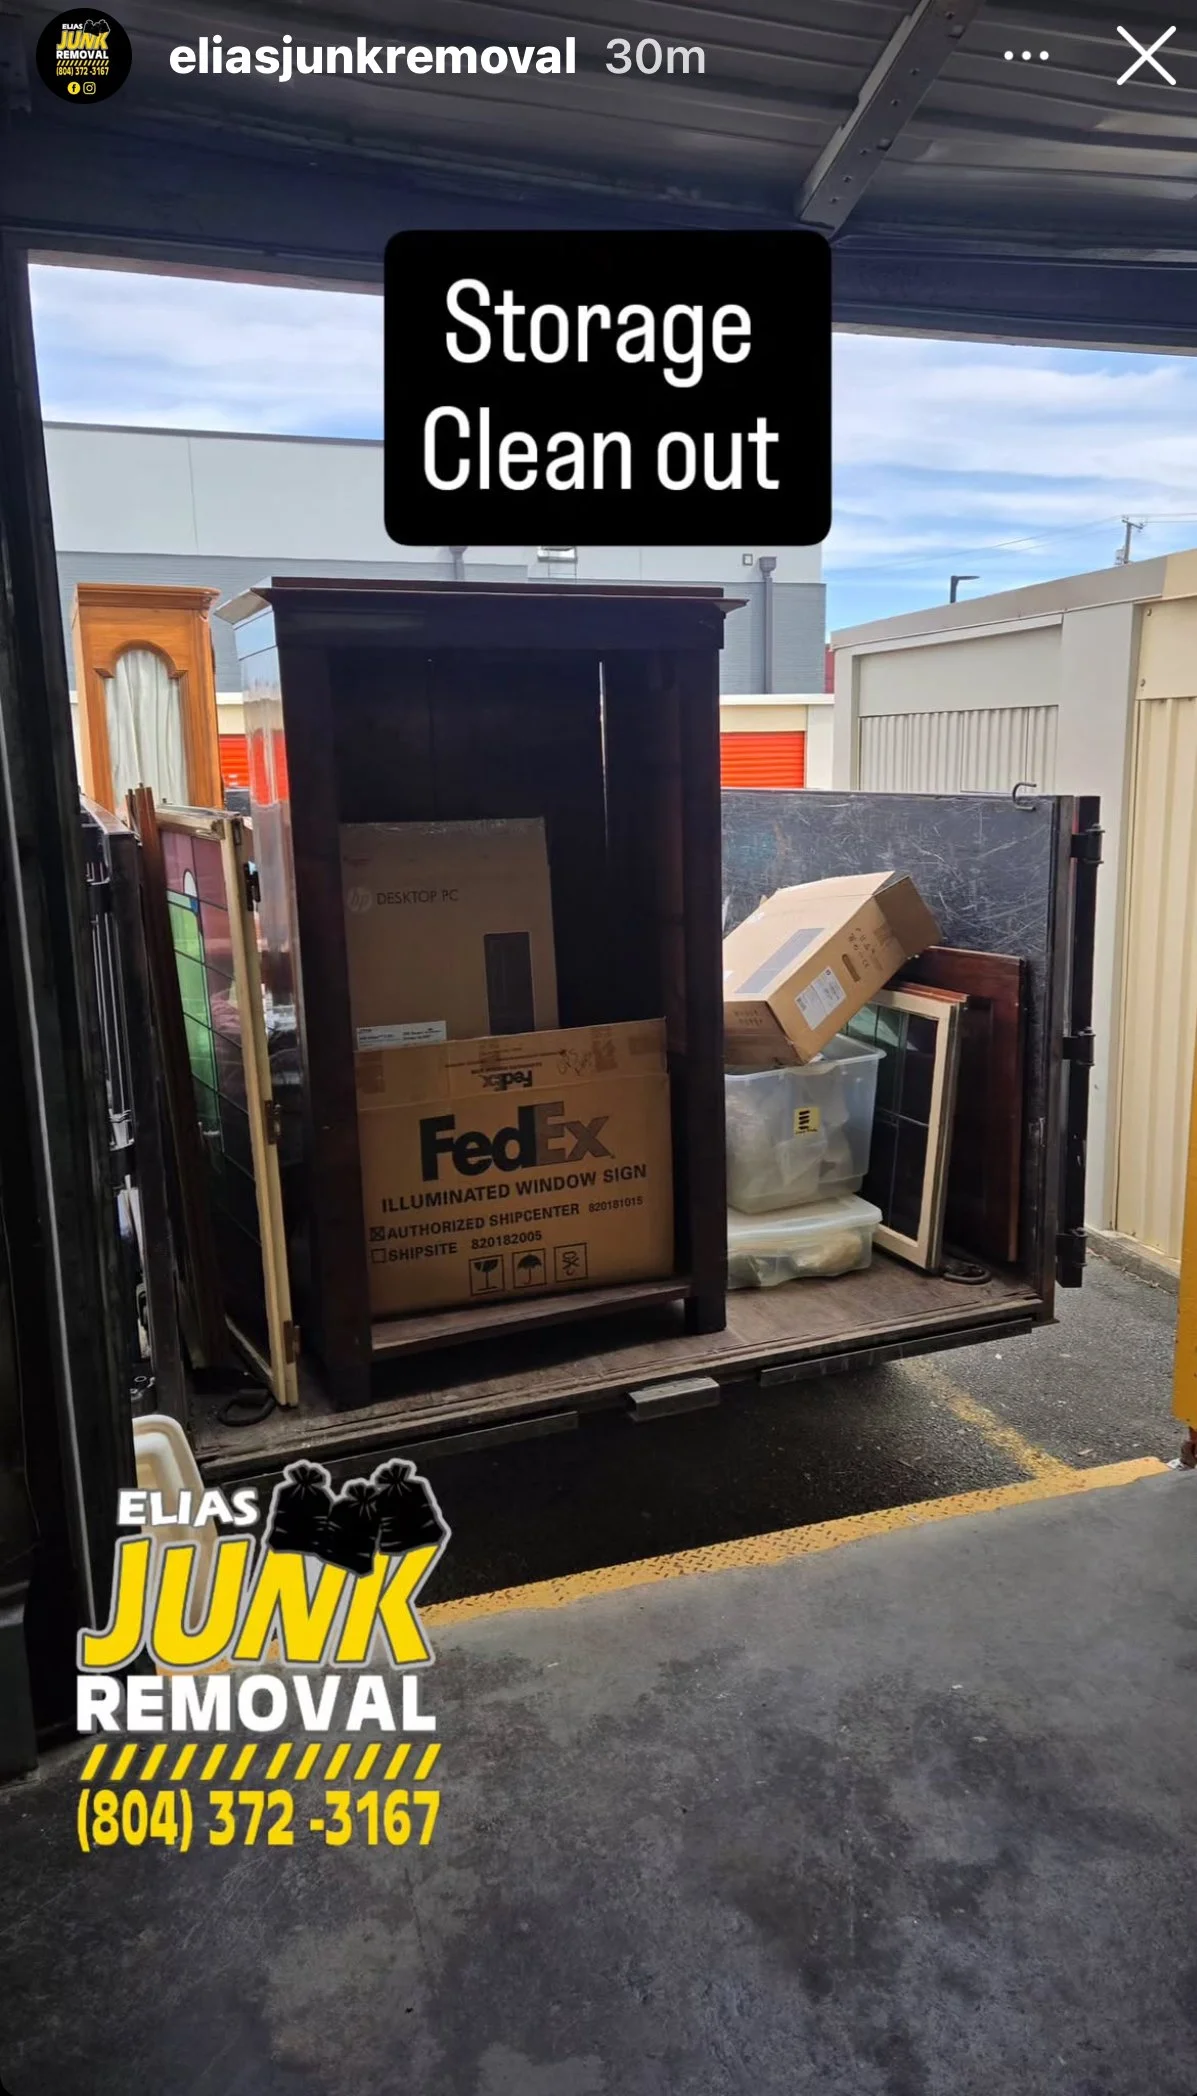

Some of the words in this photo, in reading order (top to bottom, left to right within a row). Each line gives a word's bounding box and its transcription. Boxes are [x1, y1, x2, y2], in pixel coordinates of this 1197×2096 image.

[376, 890, 437, 905] DESKTOP
[442, 888, 459, 902] PC
[477, 1070, 532, 1092] FedEx
[419, 1101, 614, 1182] FedEx
[381, 1184, 510, 1213] ILLUMINATED
[515, 1171, 597, 1196] WINDOW
[603, 1164, 647, 1183] SIGN
[387, 1217, 485, 1240] AUTHORIZED
[489, 1203, 580, 1227] SHIPCENTER
[588, 1196, 643, 1213] 820181015
[388, 1242, 458, 1262] SHIPSITE
[471, 1230, 542, 1250] 820182005
